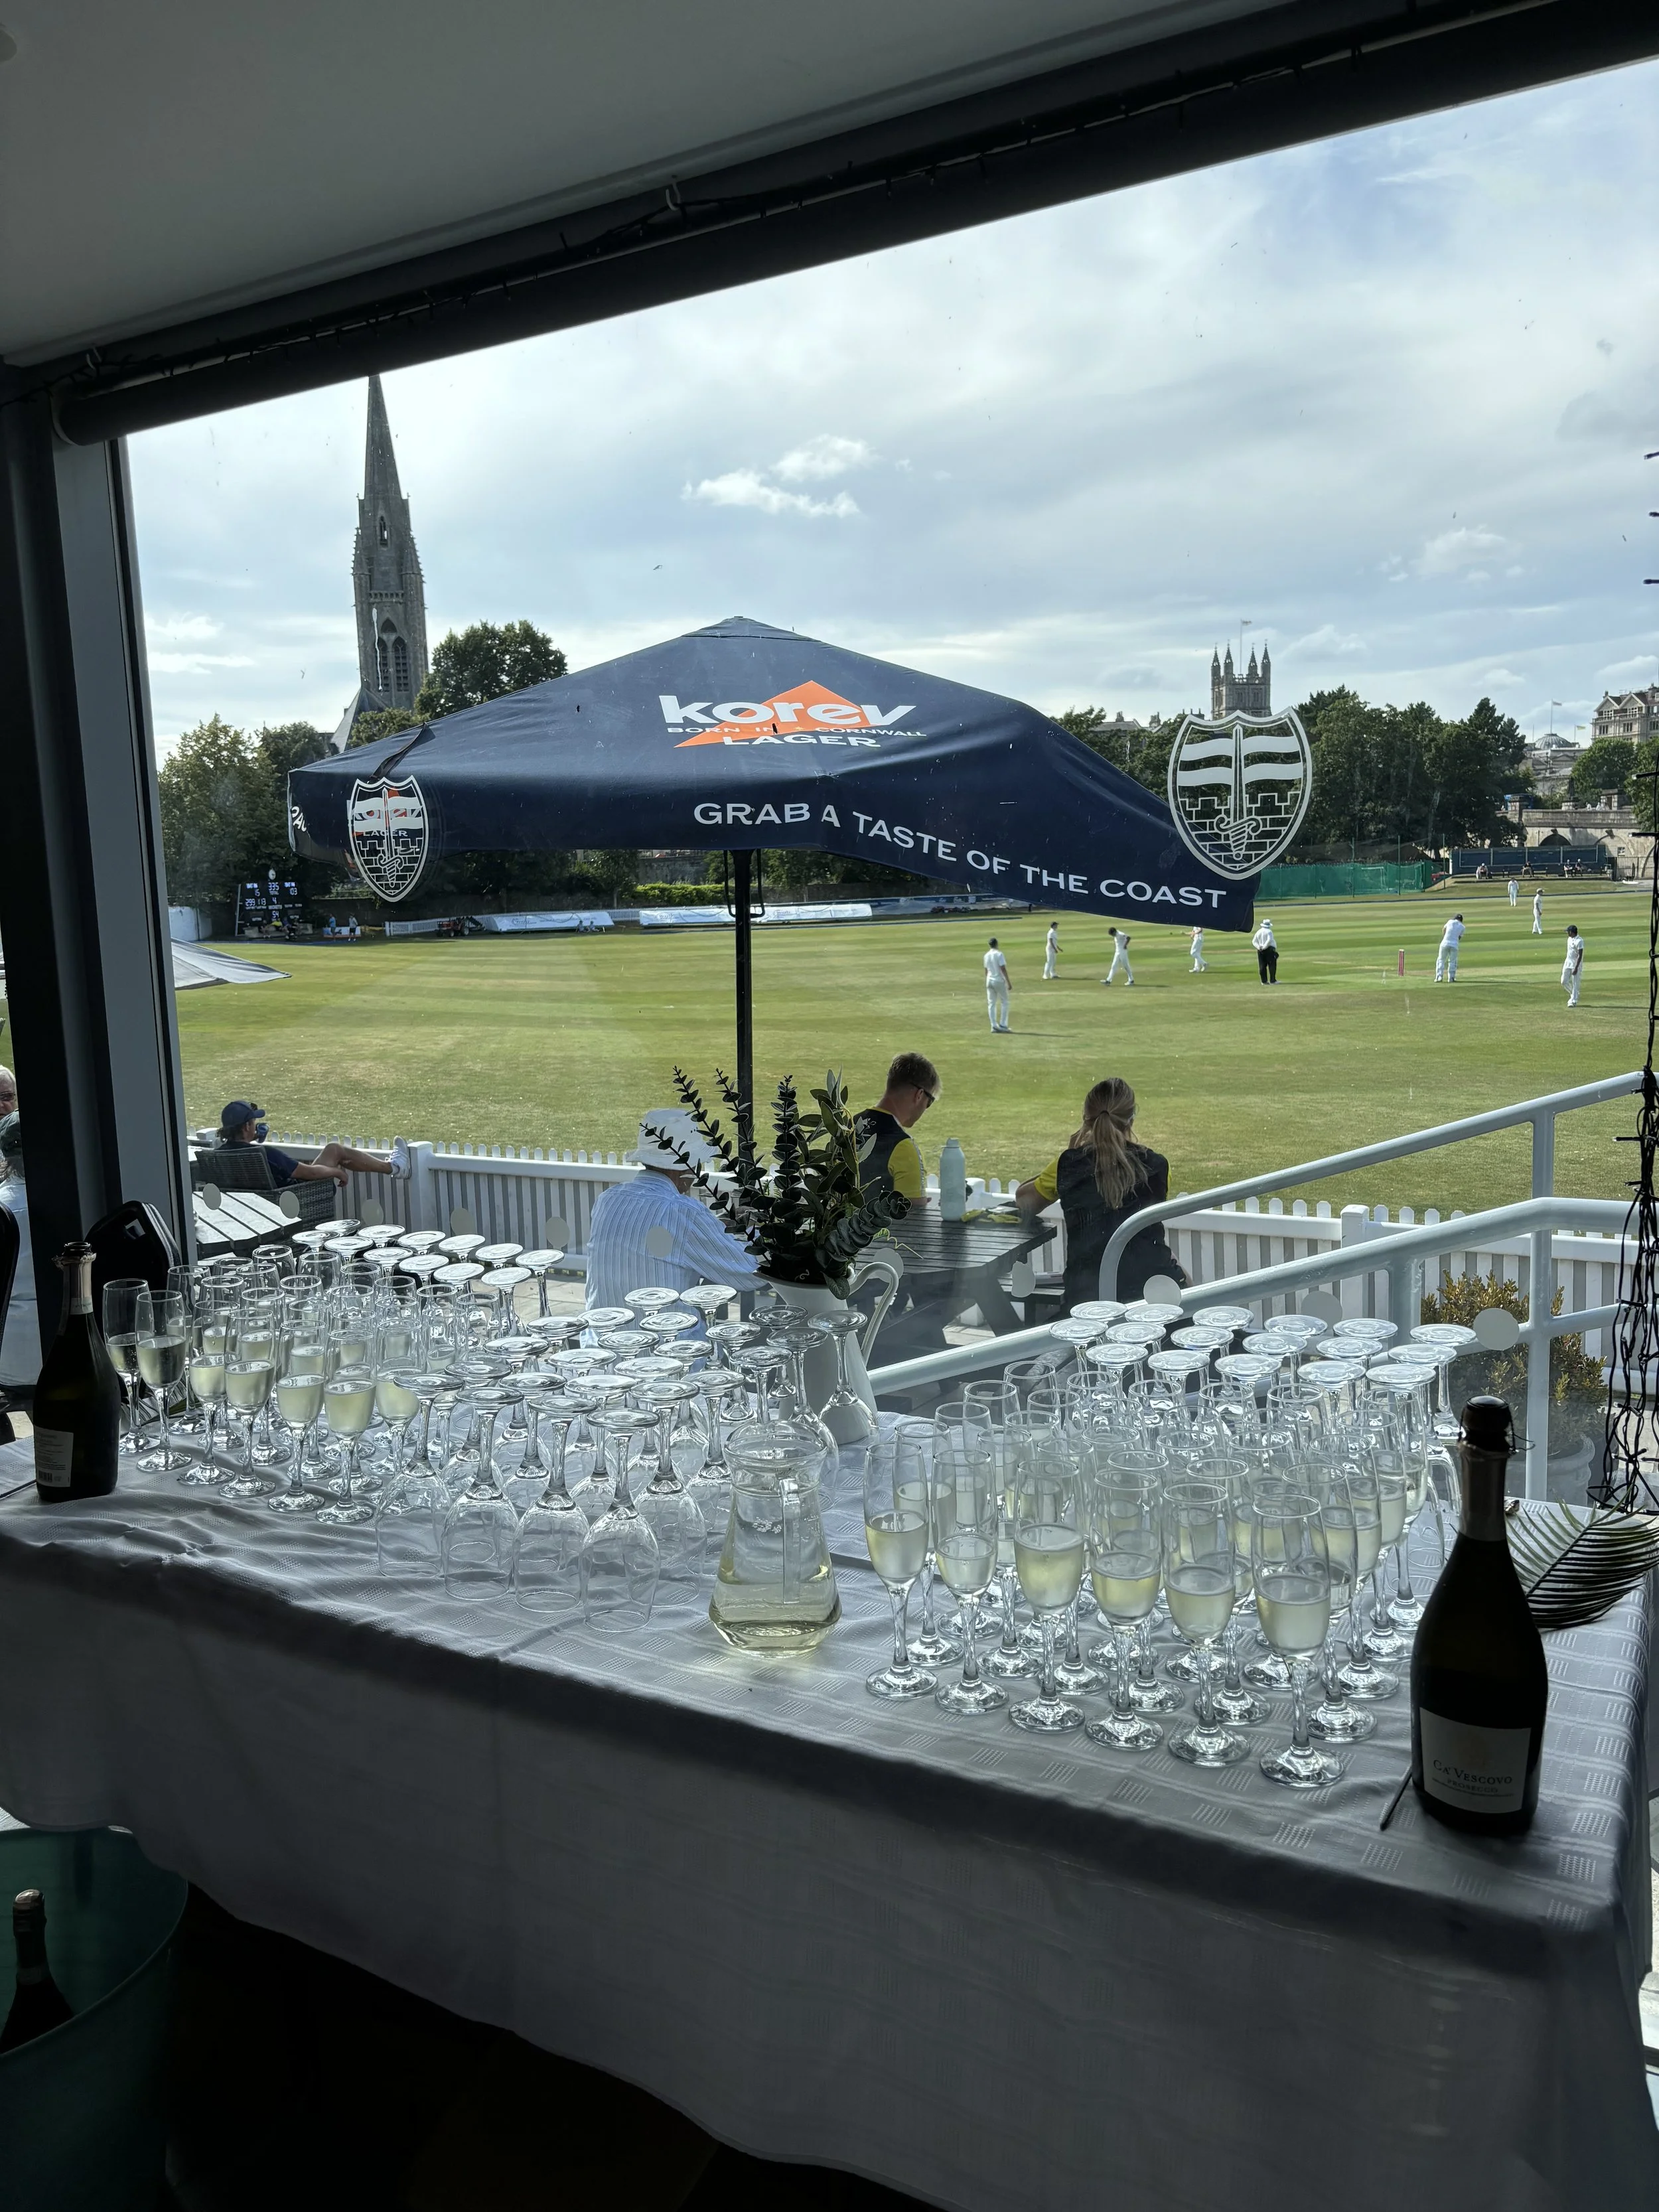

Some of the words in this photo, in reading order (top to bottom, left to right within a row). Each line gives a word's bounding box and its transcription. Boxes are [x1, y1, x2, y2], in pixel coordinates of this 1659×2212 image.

[658, 695, 916, 726] korev
[815, 727, 927, 737] CORNWALL
[724, 735, 881, 748] LAGER
[693, 802, 811, 826] GRAB
[821, 804, 841, 828] A
[852, 812, 957, 862] TASTE
[966, 850, 1011, 875] OF
[1020, 863, 1089, 895] THE
[1100, 879, 1228, 909] COAST
[268, 882, 279, 891] 335
[1447, 1779, 1498, 1793] PROSECCO
